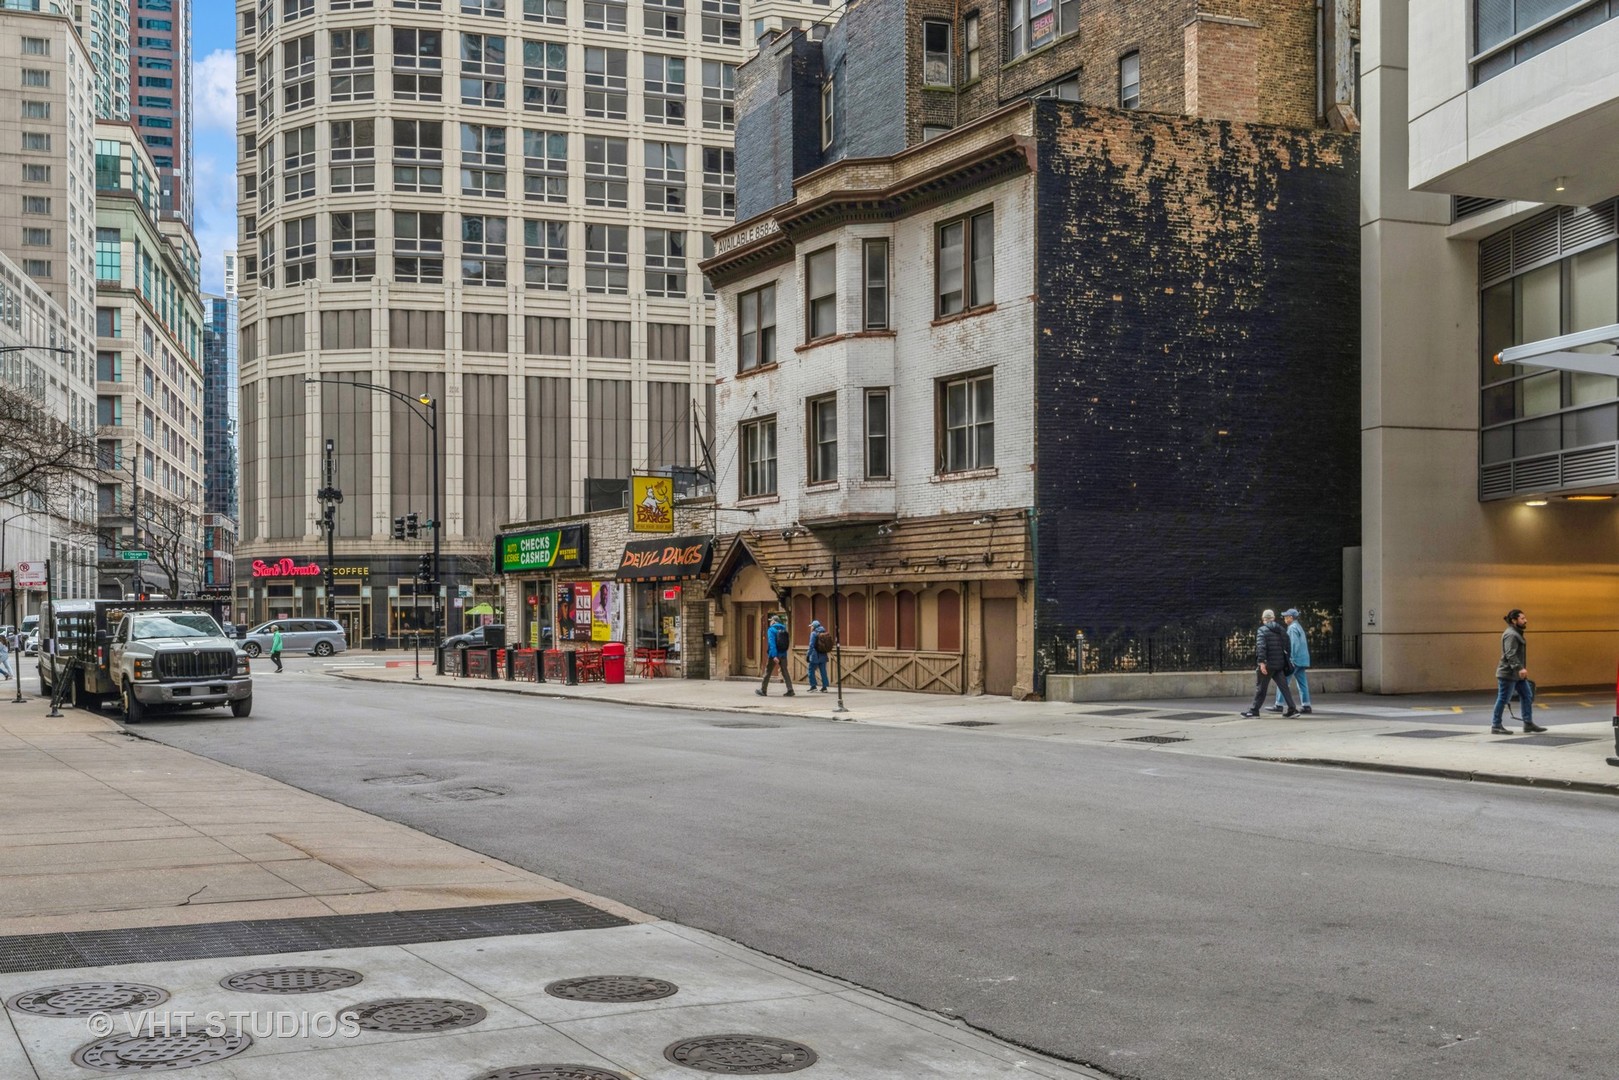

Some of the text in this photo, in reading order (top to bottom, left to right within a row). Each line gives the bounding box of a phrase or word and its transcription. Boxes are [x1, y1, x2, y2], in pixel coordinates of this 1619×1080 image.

[718, 228, 754, 254] AVAILABLE
[507, 543, 517, 552] AUTO
[520, 536, 550, 550] CHECKS
[504, 553, 520, 563] LICENSE
[520, 549, 550, 565] CASHED
[621, 544, 703, 568] DEVIL DAWGS
[279, 557, 321, 576] Donuts
[333, 567, 369, 575] COFFEE
